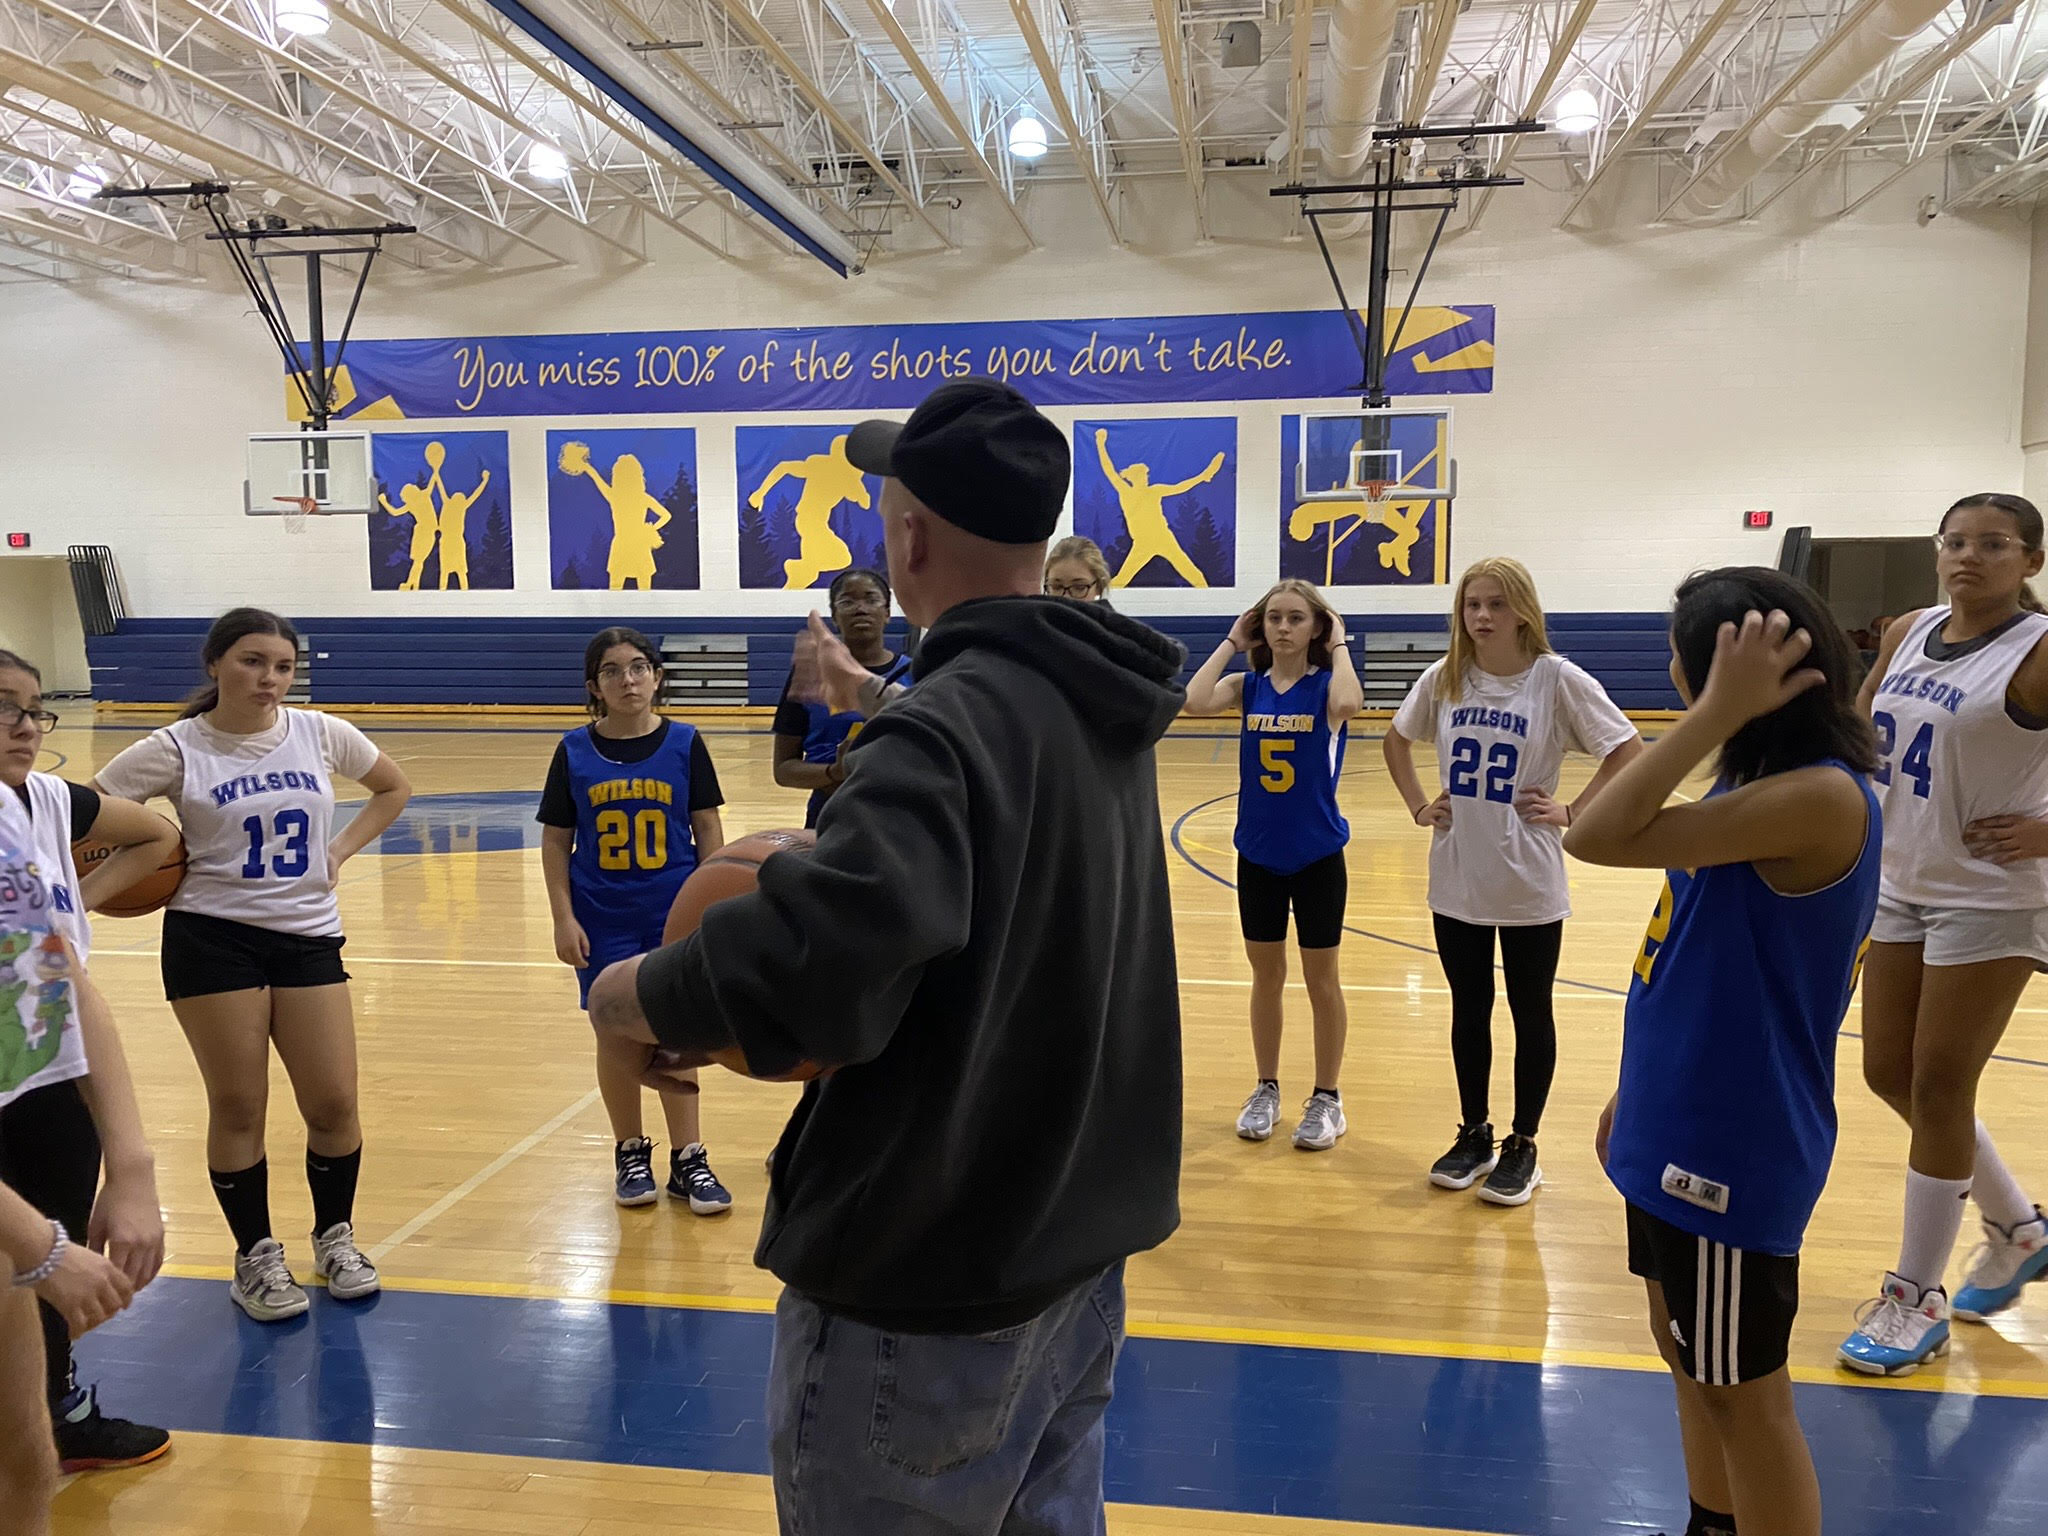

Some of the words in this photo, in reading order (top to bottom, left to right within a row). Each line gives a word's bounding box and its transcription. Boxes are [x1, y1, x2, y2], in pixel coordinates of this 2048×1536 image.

[453, 345, 529, 411] You
[538, 350, 621, 387] miss
[634, 345, 725, 388] 100%
[738, 339, 779, 383] of
[790, 339, 854, 382] the
[870, 337, 972, 380] shots
[986, 345, 1057, 383] you
[1068, 331, 1172, 376] don't
[1188, 326, 1292, 371] take.
[1751, 511, 1769, 526] EXIT
[1246, 713, 1315, 733] WILSON
[1451, 706, 1529, 739] WILSON
[1259, 738, 1296, 793] 5
[1449, 736, 1519, 804] 22
[1871, 710, 1935, 800] 24
[208, 770, 322, 809] WILSON
[587, 778, 673, 808] WILSON
[242, 808, 310, 878] 13
[596, 809, 668, 870] 20
